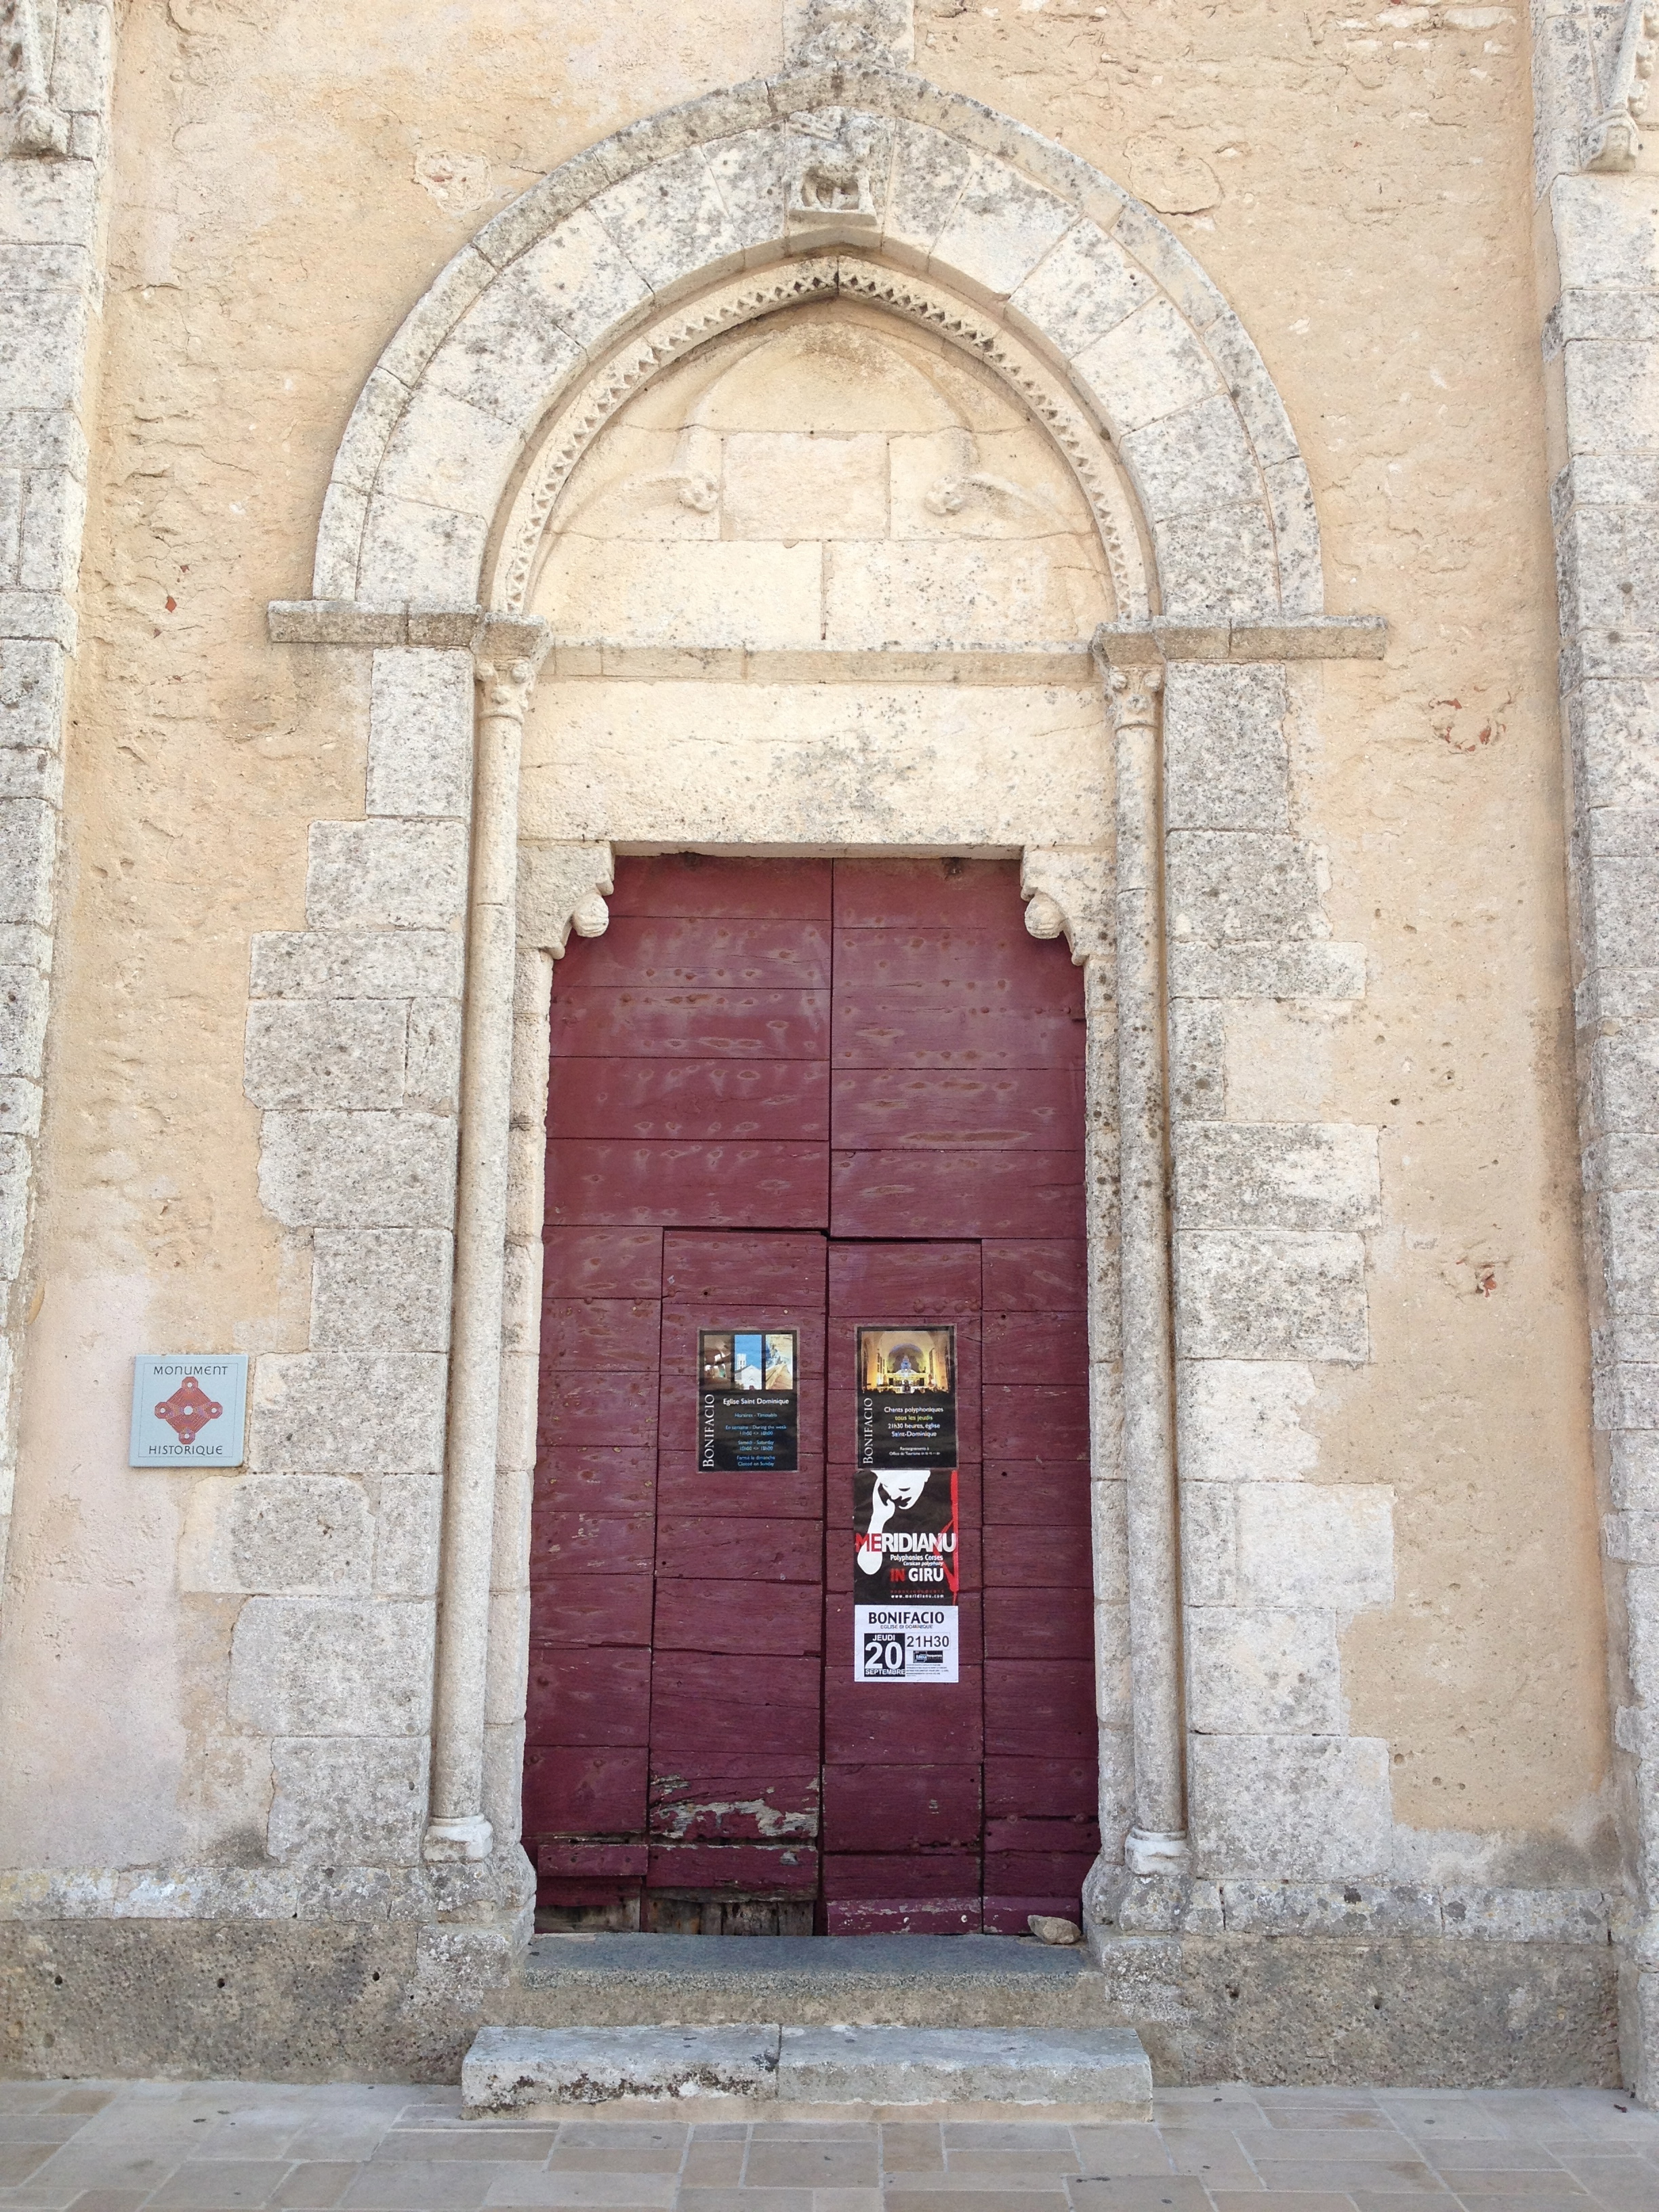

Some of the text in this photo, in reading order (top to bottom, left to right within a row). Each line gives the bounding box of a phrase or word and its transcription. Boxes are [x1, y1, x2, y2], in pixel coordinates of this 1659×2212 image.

[153, 1366, 228, 1375] MONUMENT
[905, 1406, 943, 1414] polyphoniques
[703, 1394, 715, 1467] BONIFACIO
[863, 1397, 874, 1464] BONIFACIO
[148, 1446, 223, 1456] HISTORIQUE
[855, 1532, 956, 1553] MERIDIANU
[890, 1554, 923, 1562] Polyphonies
[890, 1568, 944, 1582] IN GIRU
[868, 1612, 945, 1624] BONIFACIO
[907, 1635, 949, 1647] 21H30
[865, 1641, 903, 1669] 20
